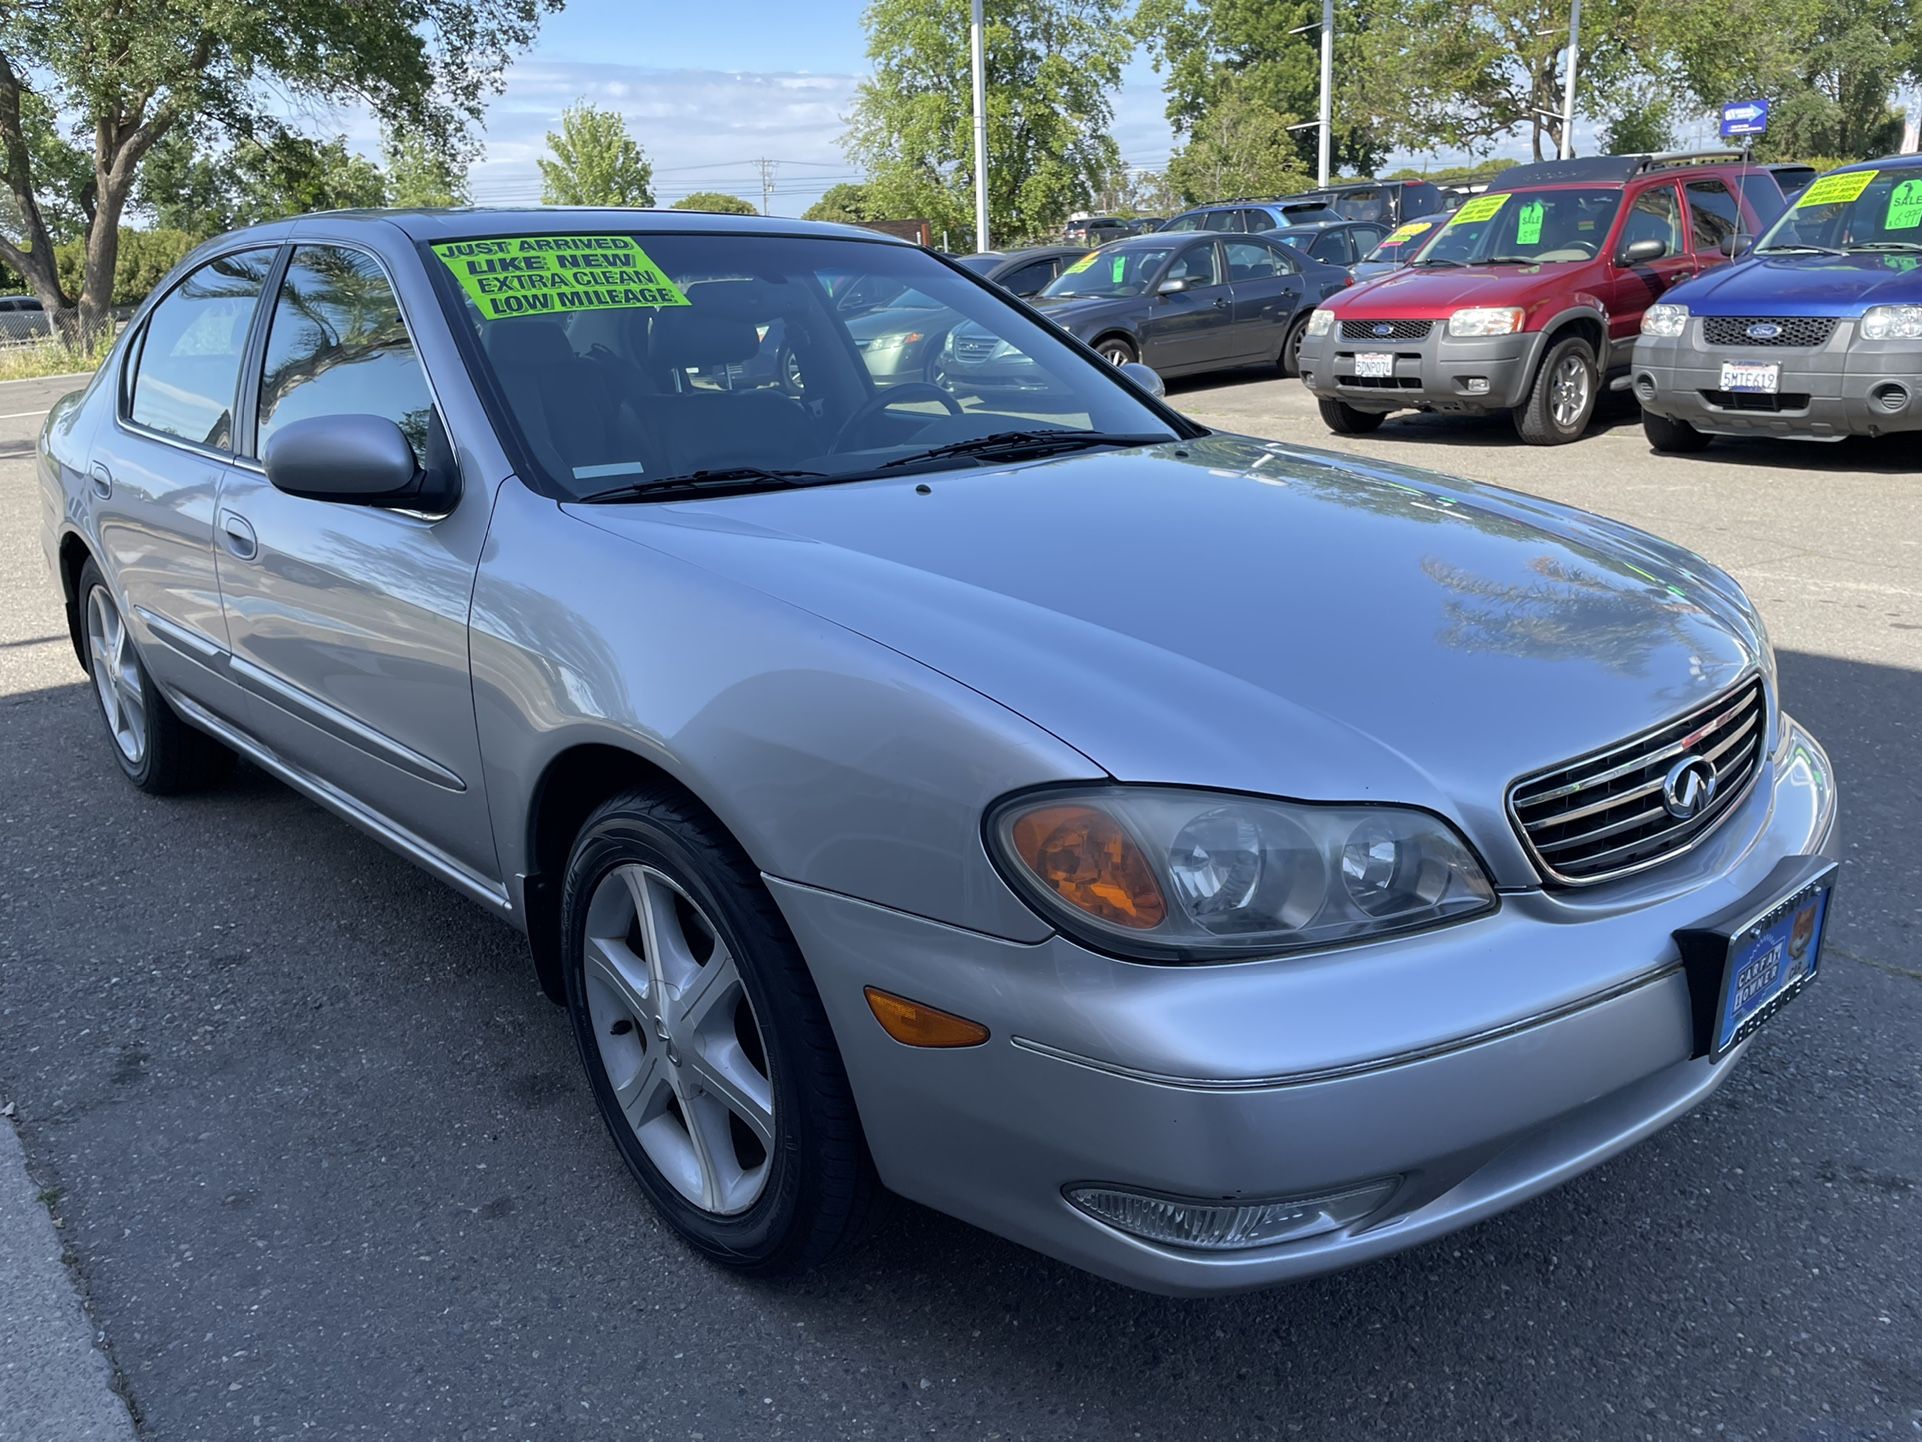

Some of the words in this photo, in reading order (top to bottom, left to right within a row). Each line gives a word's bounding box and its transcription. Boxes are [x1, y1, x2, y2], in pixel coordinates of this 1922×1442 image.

[1893, 195, 1922, 207] SALE
[1522, 215, 1541, 225] SALE
[441, 241, 513, 259] JUST
[518, 237, 635, 253] ARRIVED
[465, 255, 550, 276] LIKE
[555, 253, 637, 270] NEW
[476, 272, 574, 295] EXTRA
[572, 270, 661, 287] CLEAN
[489, 292, 555, 315] LOW
[558, 287, 678, 308] MILEAGE
[1724, 371, 1776, 389] 5MTE619
[1743, 965, 1778, 1002] OWNER
